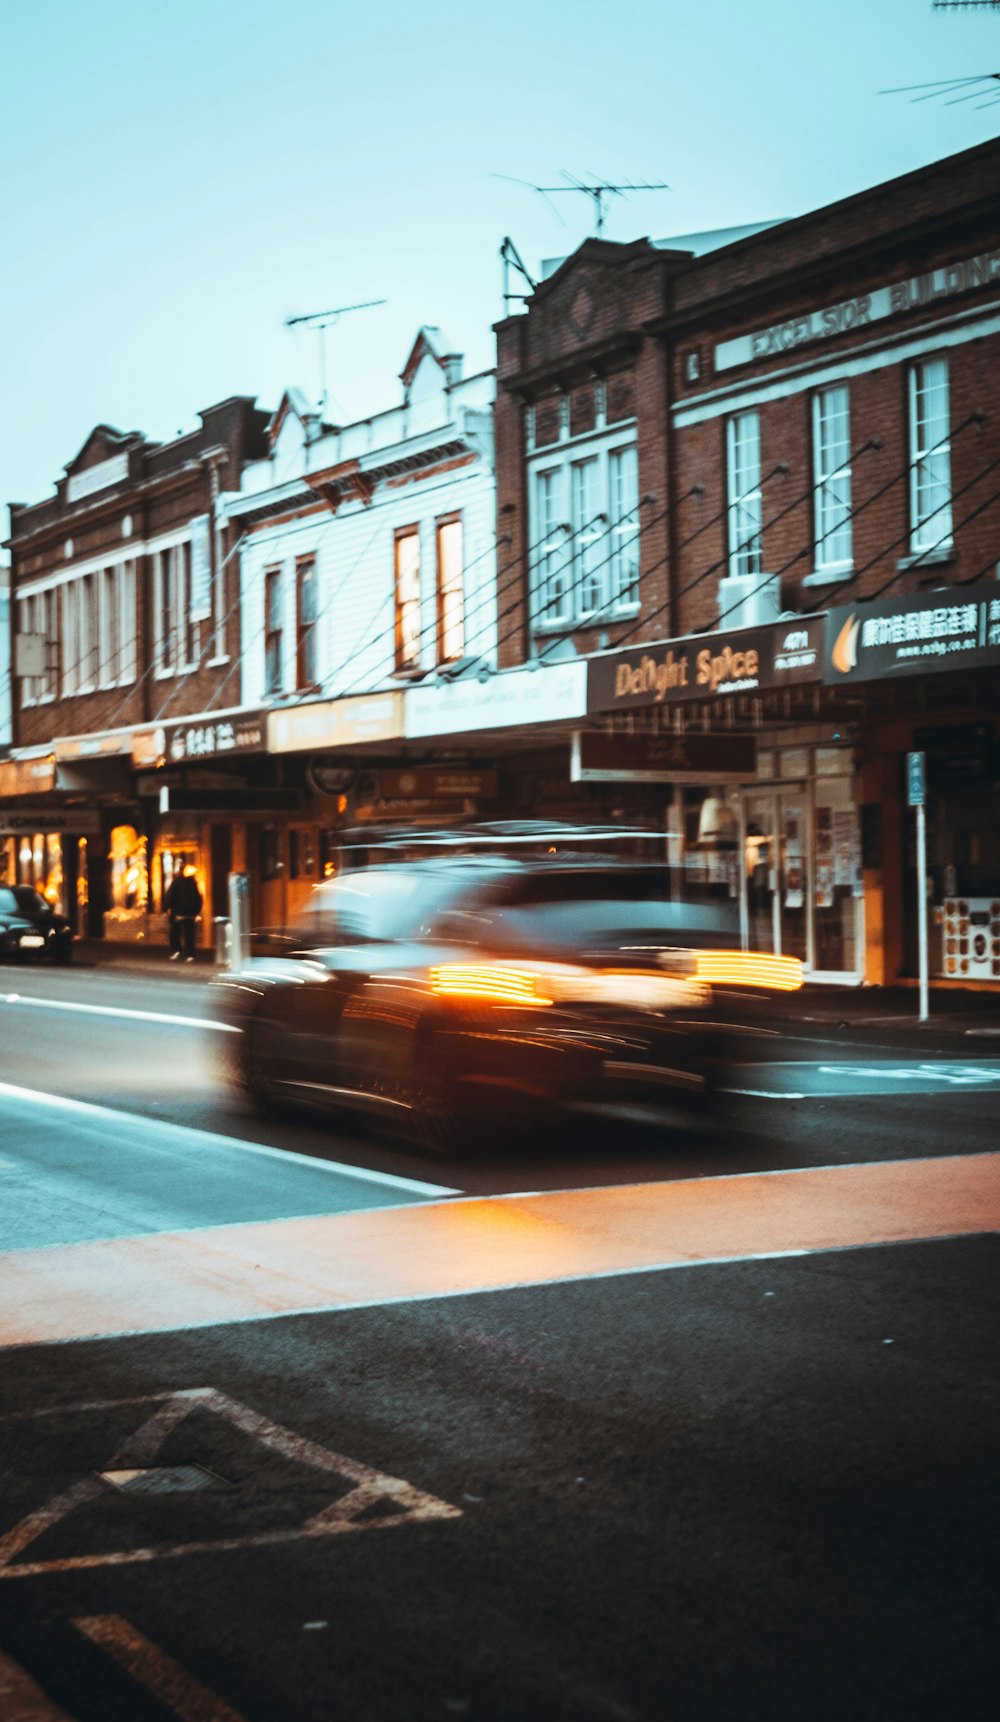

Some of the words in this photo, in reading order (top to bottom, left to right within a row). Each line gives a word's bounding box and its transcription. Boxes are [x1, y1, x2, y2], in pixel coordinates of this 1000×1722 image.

[752, 295, 872, 359] EXCELSIOR
[615, 650, 688, 702] Delight
[696, 646, 759, 693] Spice
